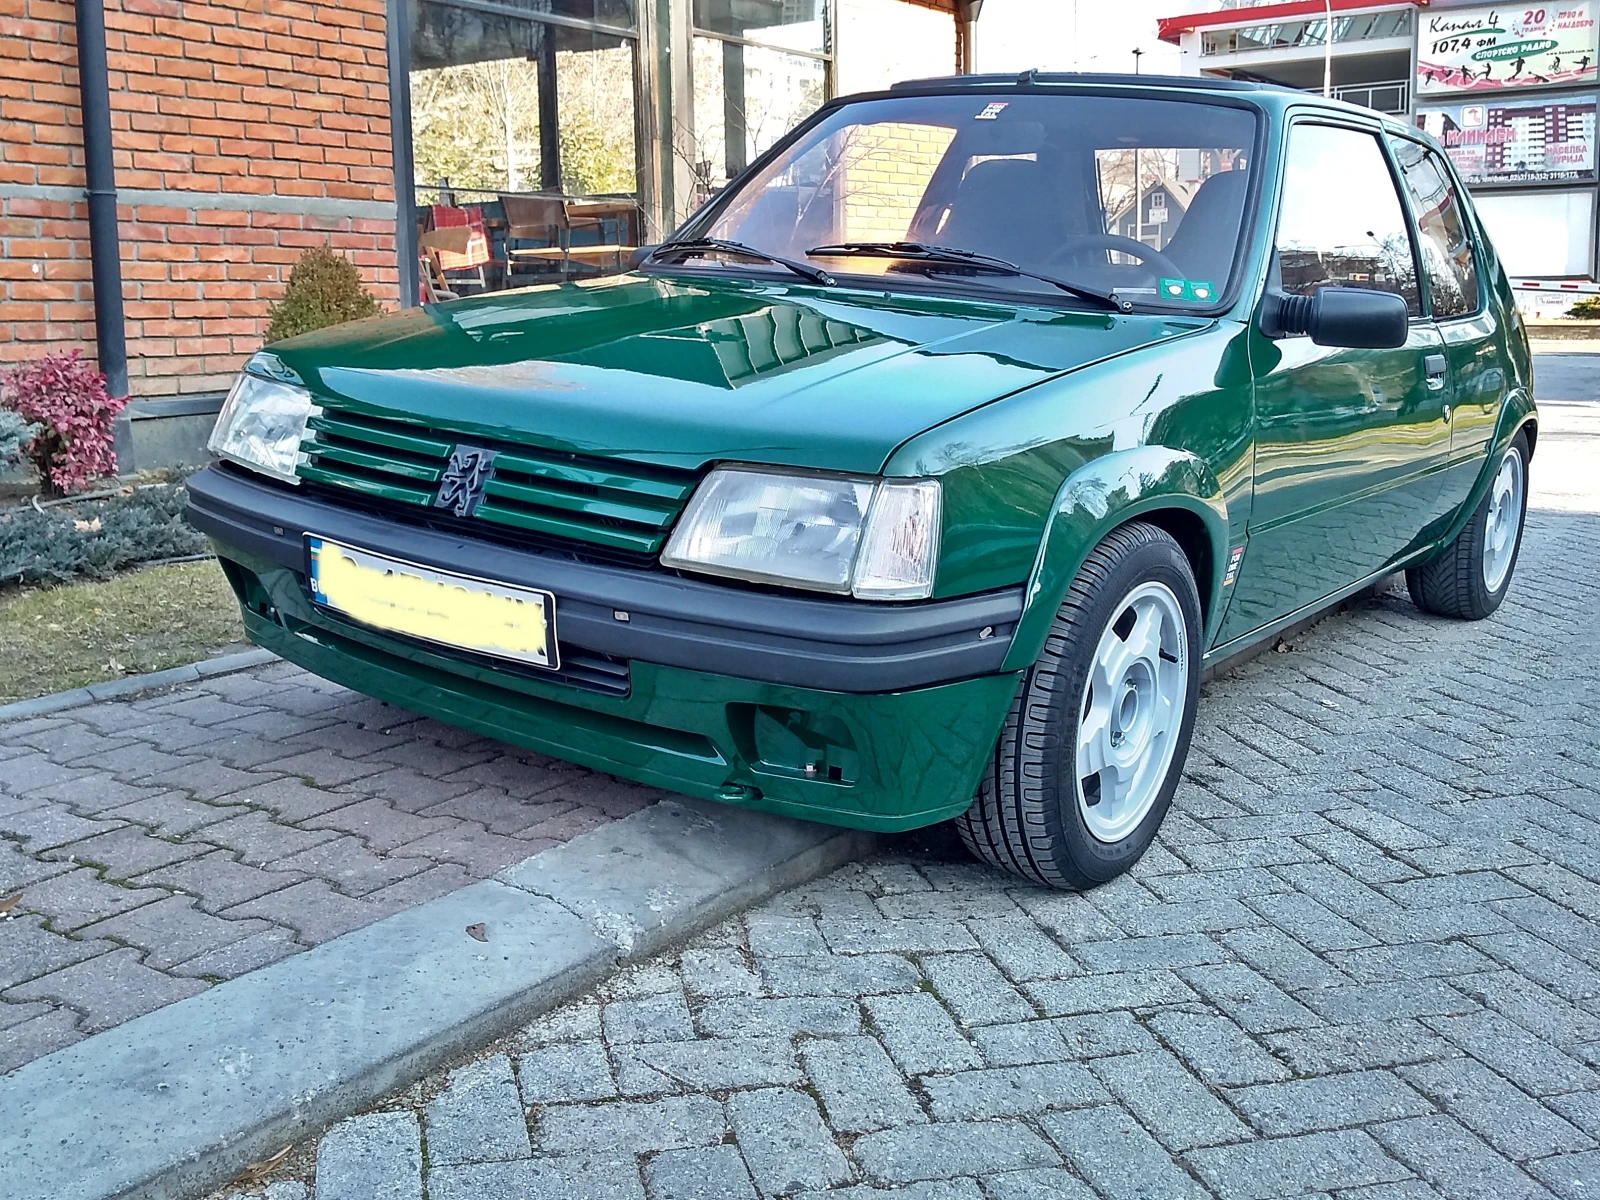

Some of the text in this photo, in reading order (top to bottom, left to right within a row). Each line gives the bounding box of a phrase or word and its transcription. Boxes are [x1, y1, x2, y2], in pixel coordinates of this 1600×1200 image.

[1429, 10, 1499, 33] Канал 4
[1523, 9, 1546, 25] 20
[1557, 11, 1577, 19] ПРВО
[1557, 20, 1594, 29] НАЈДОБРО
[1431, 37, 1497, 54] 107,4 ФМ
[1475, 40, 1552, 60] СПОРТСКО РАДИО
[1546, 145, 1588, 155] НАСЕЛБА
